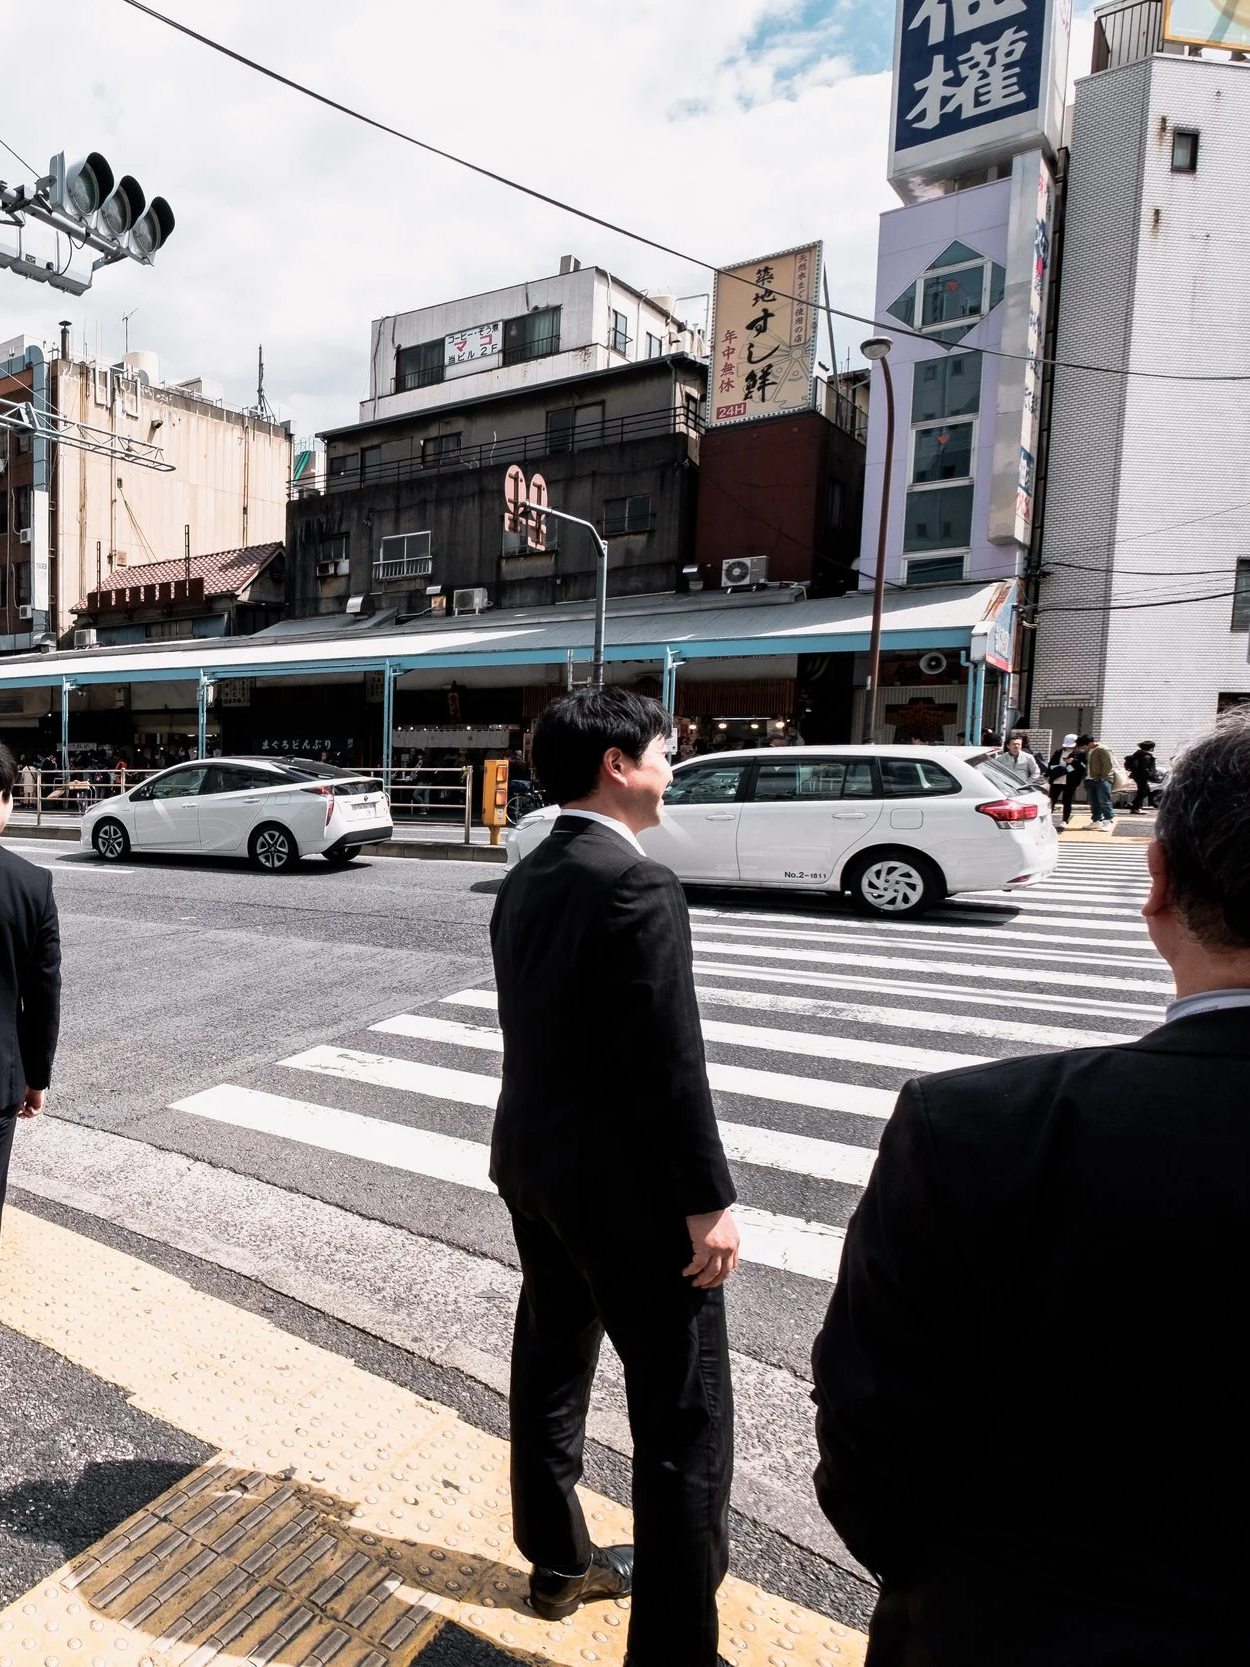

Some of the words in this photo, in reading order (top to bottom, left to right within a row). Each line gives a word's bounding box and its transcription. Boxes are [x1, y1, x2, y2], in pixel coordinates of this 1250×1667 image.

[743, 266, 781, 403] 築地すし鮮
[718, 330, 738, 393] 年中無休
[718, 405, 745, 418] 24H
[261, 738, 331, 750] まぐろどんぶり
[784, 871, 828, 879] No.2-1811
